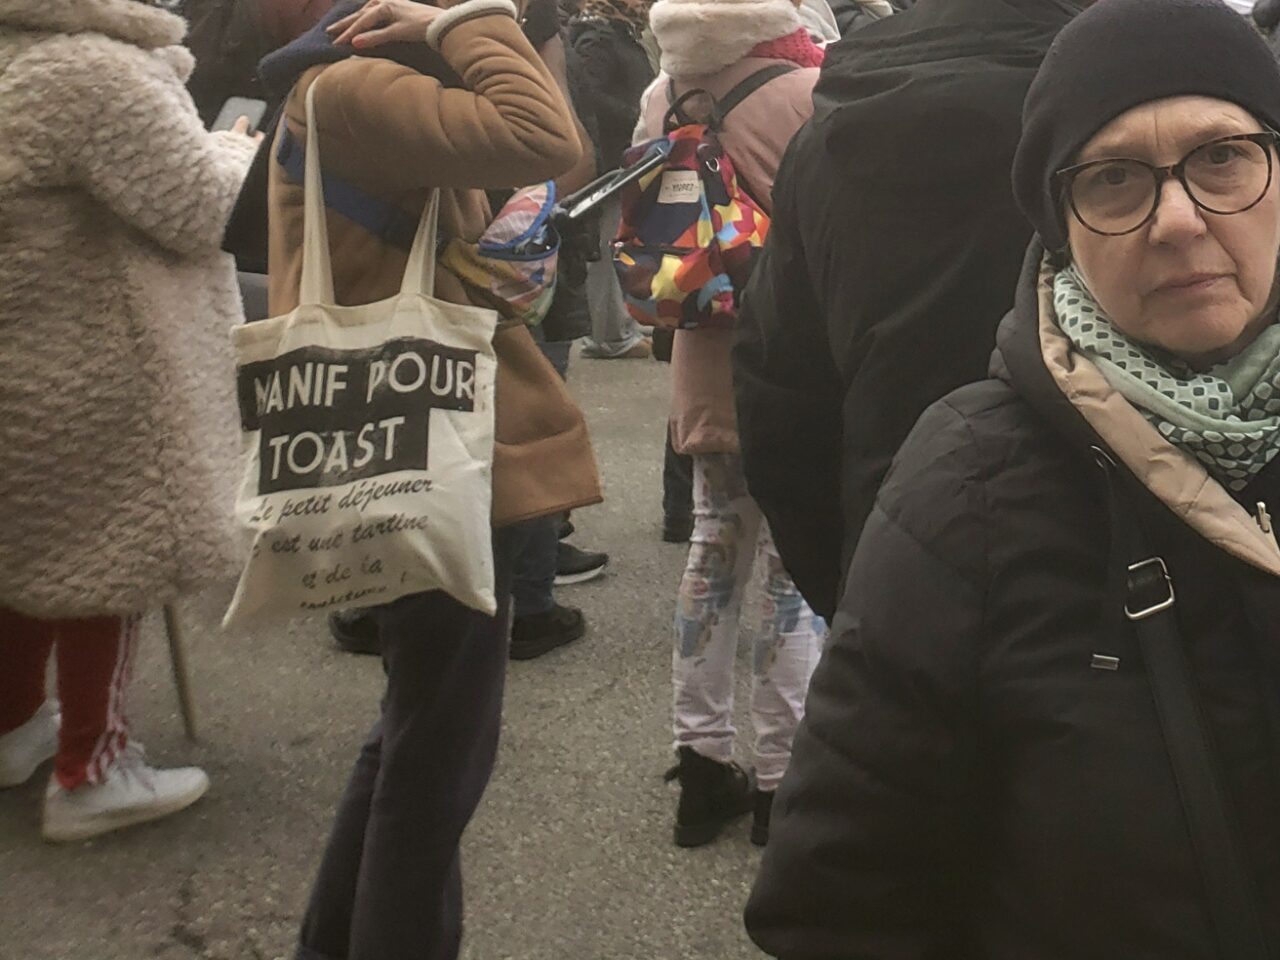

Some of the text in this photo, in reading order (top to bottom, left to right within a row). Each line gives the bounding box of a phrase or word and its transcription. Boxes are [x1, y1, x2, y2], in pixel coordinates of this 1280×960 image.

[366, 351, 475, 404] POUR
[269, 416, 405, 480] TOAST
[276, 493, 332, 524] petit
[338, 478, 435, 511] déjeuner
[352, 513, 429, 543] tartine
